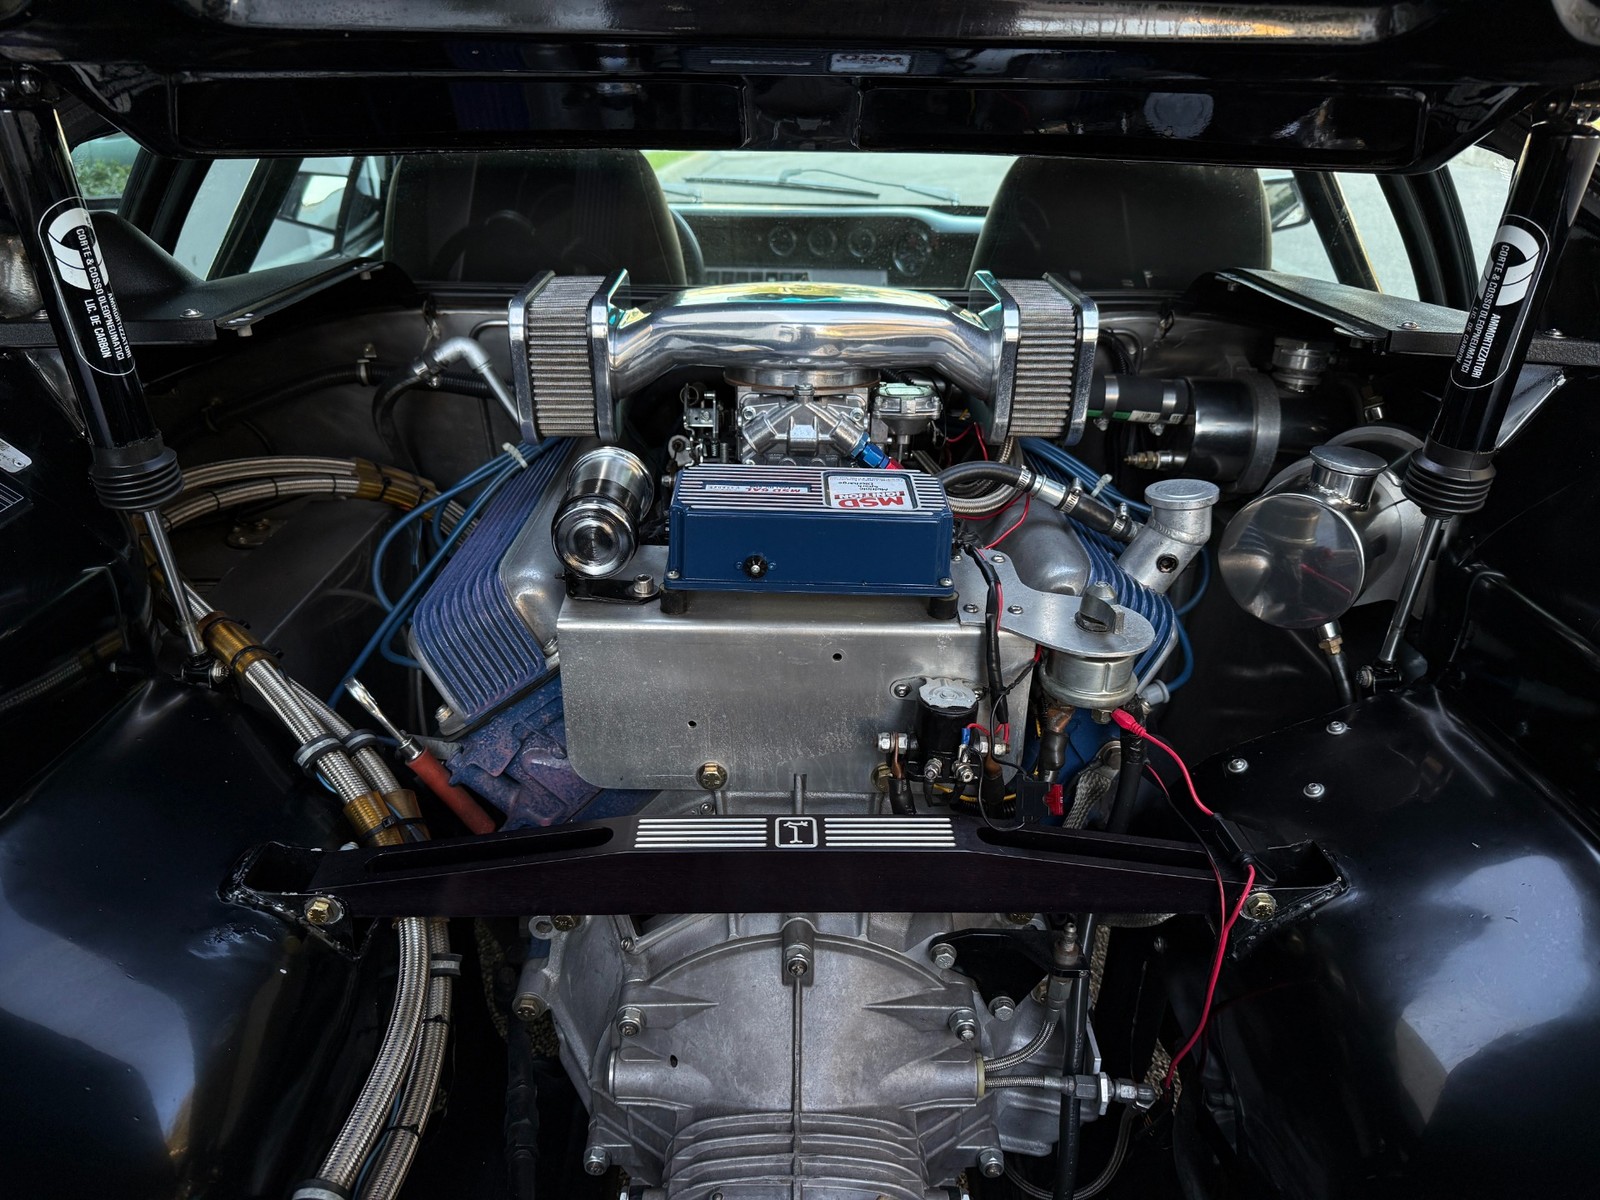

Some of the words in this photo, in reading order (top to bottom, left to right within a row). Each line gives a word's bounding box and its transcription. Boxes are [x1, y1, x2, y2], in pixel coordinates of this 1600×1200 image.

[76, 228, 92, 258] CORTE
[86, 257, 94, 265] &
[1494, 244, 1510, 273] CORTE
[88, 265, 104, 295] COSSO
[84, 298, 97, 314] LIC.
[1481, 281, 1497, 310] COSSO
[90, 314, 101, 326] DE
[97, 295, 126, 361] OLEOPNEUMATICI
[1466, 322, 1473, 332] DE
[94, 327, 112, 359] CARBON
[1455, 335, 1469, 364] CARBON
[1460, 309, 1488, 374] OLEOPNEUMATICI
[1471, 313, 1501, 379] AMMORTIZZATORI
[838, 496, 904, 508] MSD
